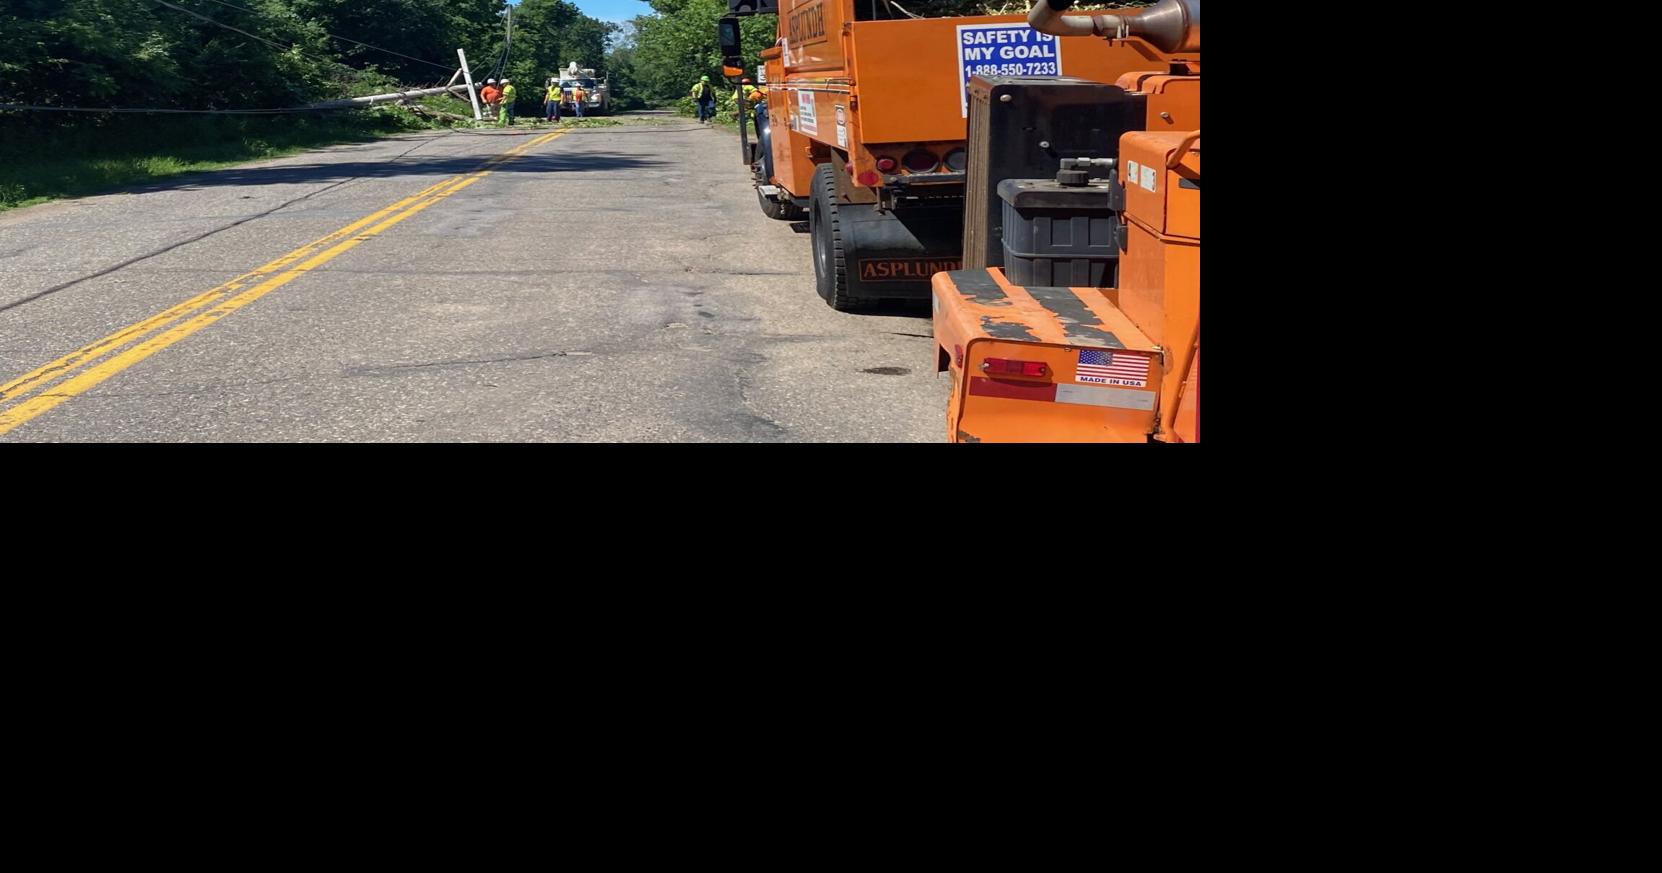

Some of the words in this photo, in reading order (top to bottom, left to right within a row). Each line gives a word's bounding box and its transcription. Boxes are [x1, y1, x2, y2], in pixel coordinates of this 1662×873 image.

[963, 29, 1031, 44] SAFETY
[964, 46, 995, 60] MY
[999, 45, 1055, 59] GOAL
[965, 62, 1056, 77] 1-888-550-7233
[1080, 376, 1106, 384] MADE
